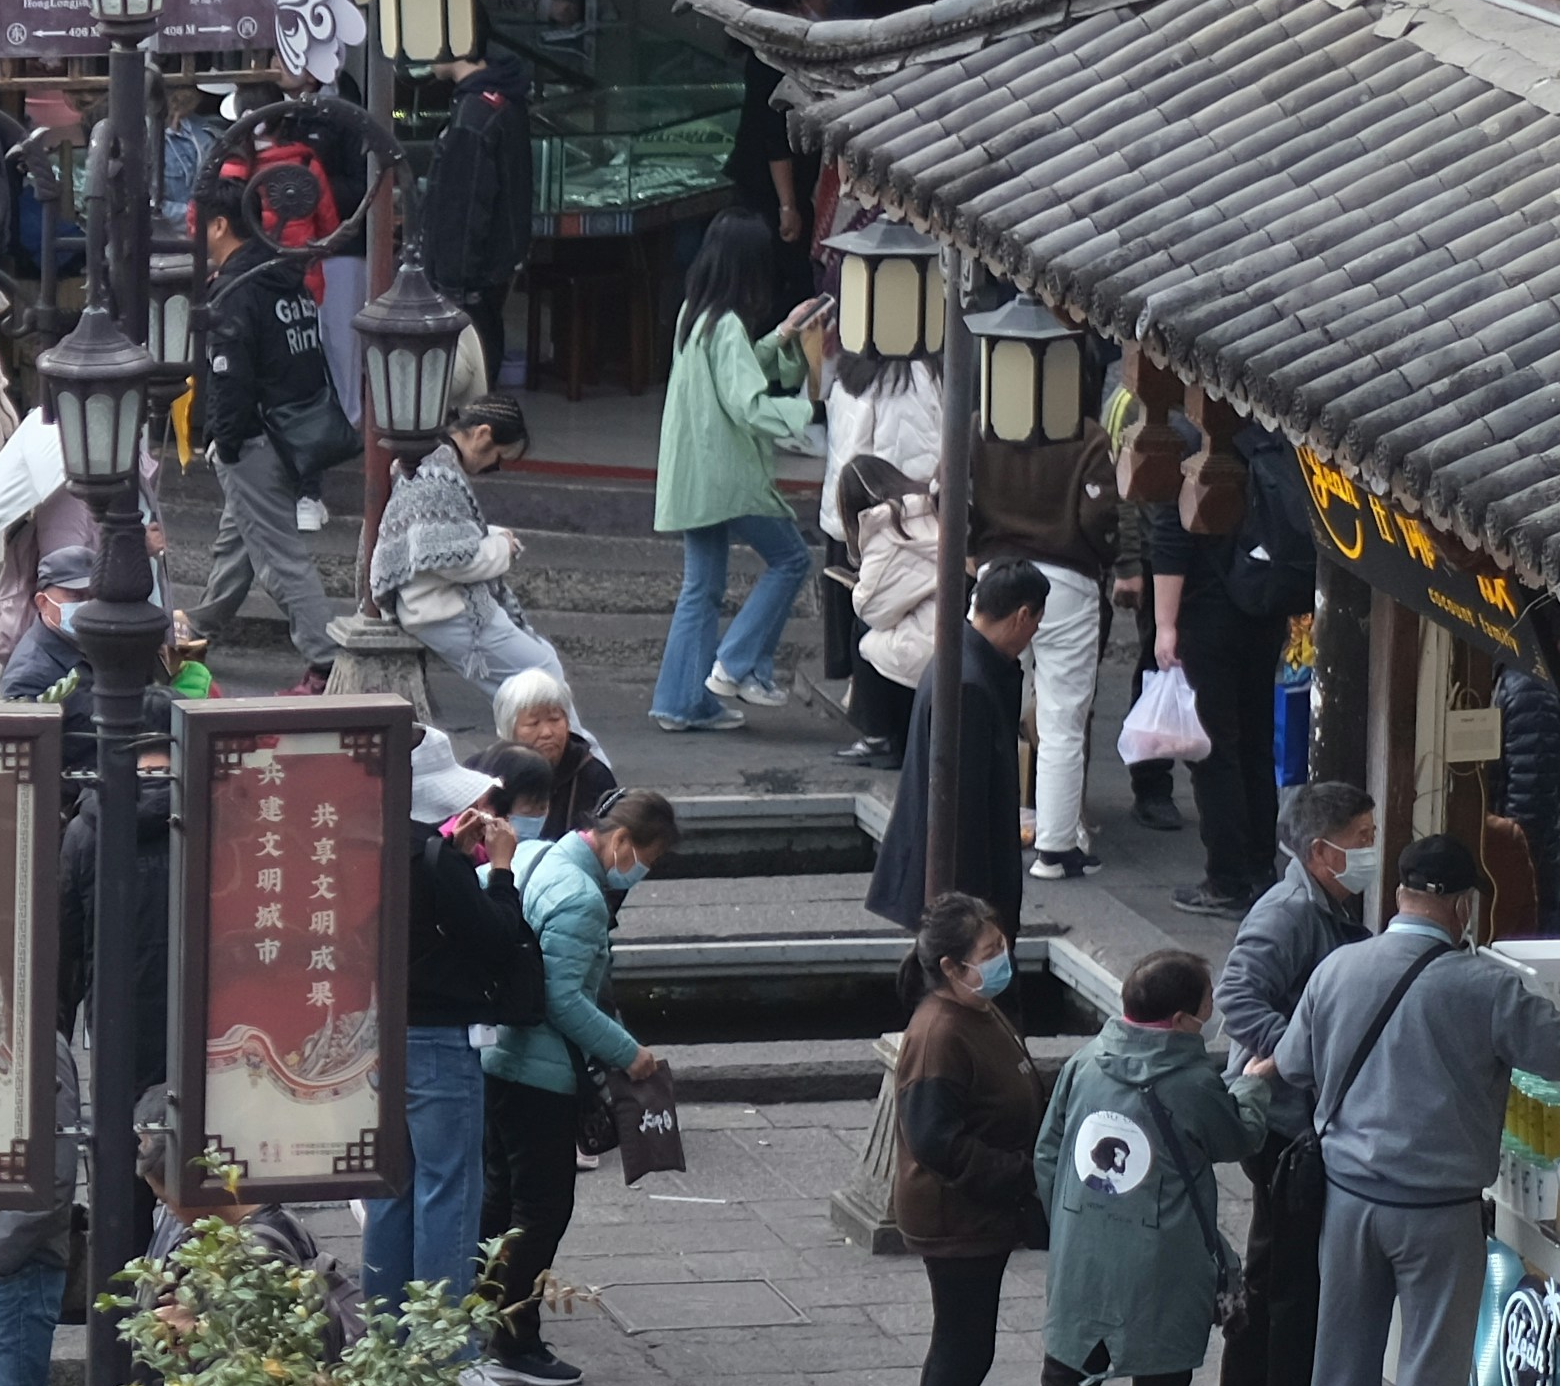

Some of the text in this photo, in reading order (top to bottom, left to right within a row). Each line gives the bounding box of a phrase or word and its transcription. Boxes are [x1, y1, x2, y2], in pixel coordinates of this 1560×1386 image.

[254, 760, 284, 966] 共建文明城市
[306, 803, 339, 1007] 共享文明成果
